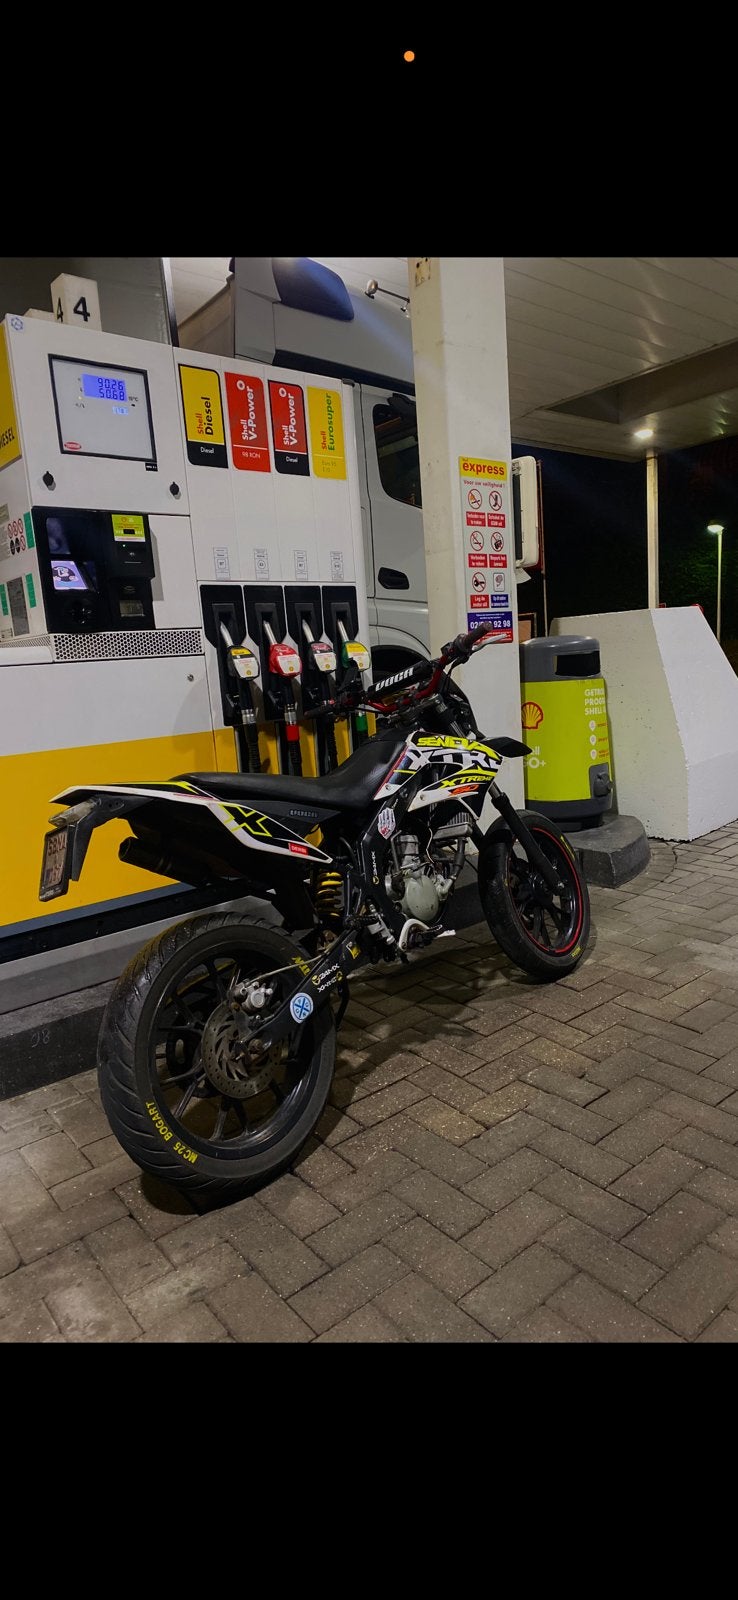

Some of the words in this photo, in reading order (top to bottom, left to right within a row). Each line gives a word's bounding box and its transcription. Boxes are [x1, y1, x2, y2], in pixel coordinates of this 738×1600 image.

[73, 297, 90, 322] 4
[195, 413, 204, 434] Shell
[201, 396, 214, 435] Diesel
[246, 386, 258, 441] V-Power
[288, 393, 298, 446] V-Power
[325, 393, 335, 451] Eurosuper
[240, 419, 249, 440] Shell
[282, 425, 290, 446] Shell
[200, 446, 215, 454] Diesel
[462, 462, 505, 476] express
[493, 620, 502, 628] 92
[502, 619, 511, 627] 98
[416, 735, 502, 763] SENDA
[145, 1101, 174, 1141] BOGART
